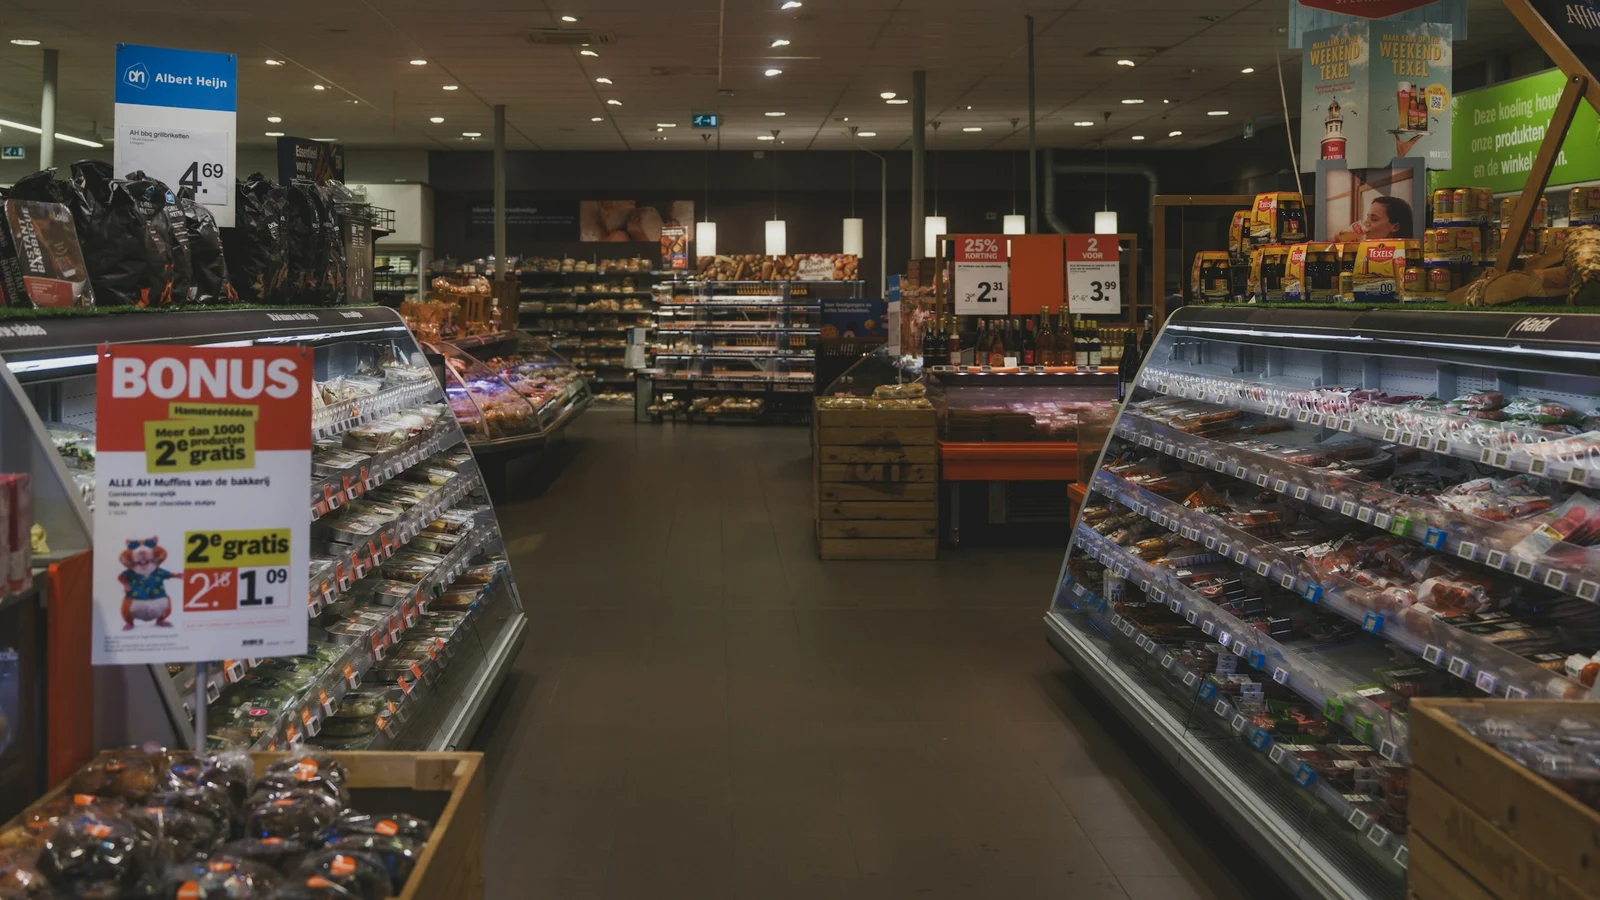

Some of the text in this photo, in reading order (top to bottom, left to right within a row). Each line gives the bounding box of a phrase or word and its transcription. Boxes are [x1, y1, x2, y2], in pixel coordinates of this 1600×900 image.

[1566, 4, 1600, 30] Affli
[1310, 45, 1360, 67] WEEKEND
[1380, 42, 1442, 60] WEEKEND
[1320, 63, 1350, 81] TEXEL
[1392, 60, 1429, 77] TEXEL
[155, 73, 228, 89] Albert Heijn
[1474, 88, 1564, 126] Deze koeling houd
[154, 131, 190, 139] grillbriketten
[1471, 124, 1545, 153] onze produkten
[1473, 164, 1485, 178] en
[1487, 159, 1499, 176] de
[1501, 151, 1533, 174] winkel
[179, 161, 224, 193] 4.69
[18, 219, 38, 272] INSTANT
[22, 206, 46, 272] BARBECUE
[965, 238, 998, 252] 25%
[1087, 238, 1099, 251] 2
[1369, 248, 1393, 258] TEXELS
[977, 282, 1003, 302] 2.31
[1090, 281, 1117, 301] 3.99
[1515, 317, 1560, 332] Halal
[112, 357, 299, 400] BONUS
[156, 424, 245, 438] Meer dan 1000
[190, 435, 245, 448] producten
[190, 443, 246, 465] gratis
[109, 479, 133, 487] ALLE
[136, 479, 151, 487] AH
[154, 478, 191, 487] Muffins
[215, 478, 228, 486] de
[231, 477, 270, 488] bakkerij
[223, 534, 290, 561] gratis
[240, 568, 288, 606] 1.09
